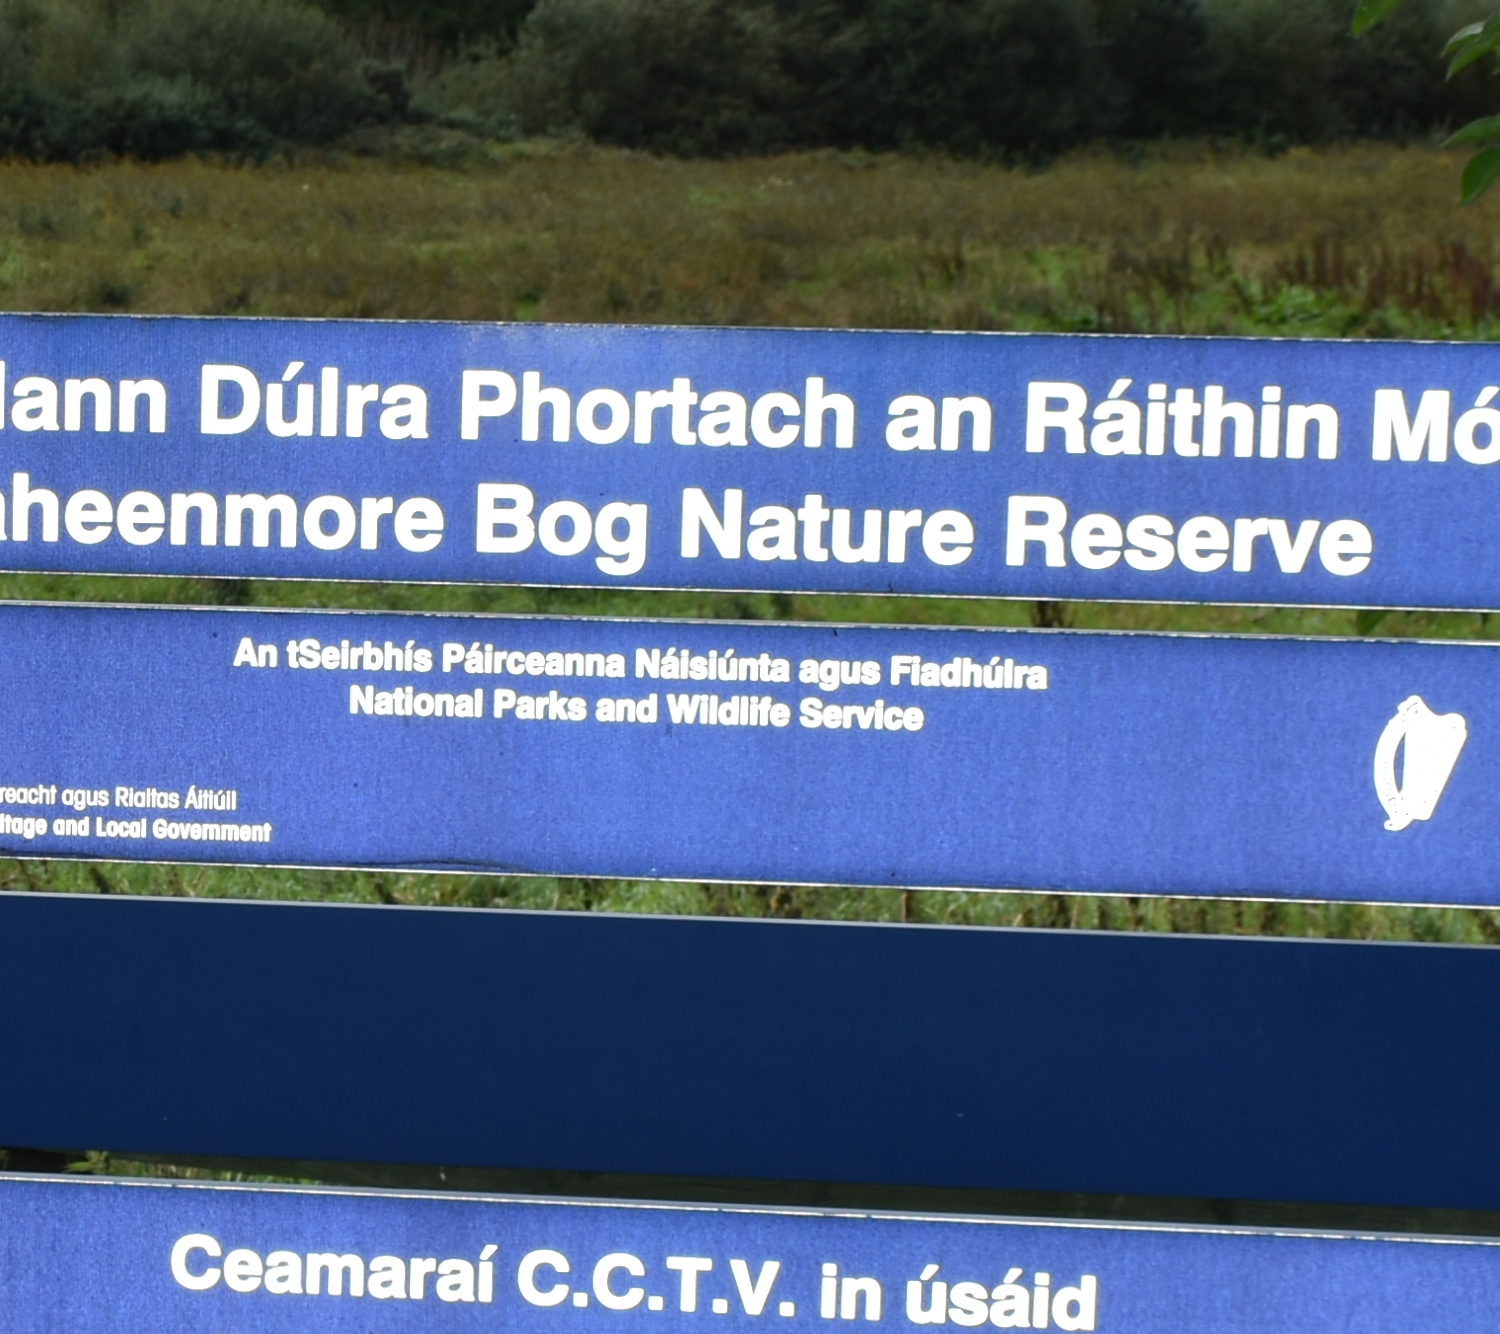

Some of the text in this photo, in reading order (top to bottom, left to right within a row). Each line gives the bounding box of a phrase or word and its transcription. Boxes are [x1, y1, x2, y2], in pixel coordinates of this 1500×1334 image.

[201, 362, 428, 439] Dúlra
[461, 370, 854, 448] Phortach
[886, 395, 991, 451] an
[1026, 379, 1338, 459] Ráithin
[476, 483, 647, 569] Bog
[681, 488, 974, 565] Nature
[1006, 496, 1372, 576] Reserve
[233, 638, 1047, 689] An tSeirbhís Páirceanna Náisiúnta agus Fiadhúlra
[350, 685, 924, 731] National Parks and Wildlife Service
[62, 789, 109, 810] agus
[115, 787, 180, 808] Rialtas
[185, 785, 236, 810] Áitiúil
[53, 816, 89, 836] and
[96, 817, 146, 838] Local
[153, 819, 272, 842] Government
[171, 1234, 1096, 1331] Ceamaraí C.C.T.V. in úsáid
